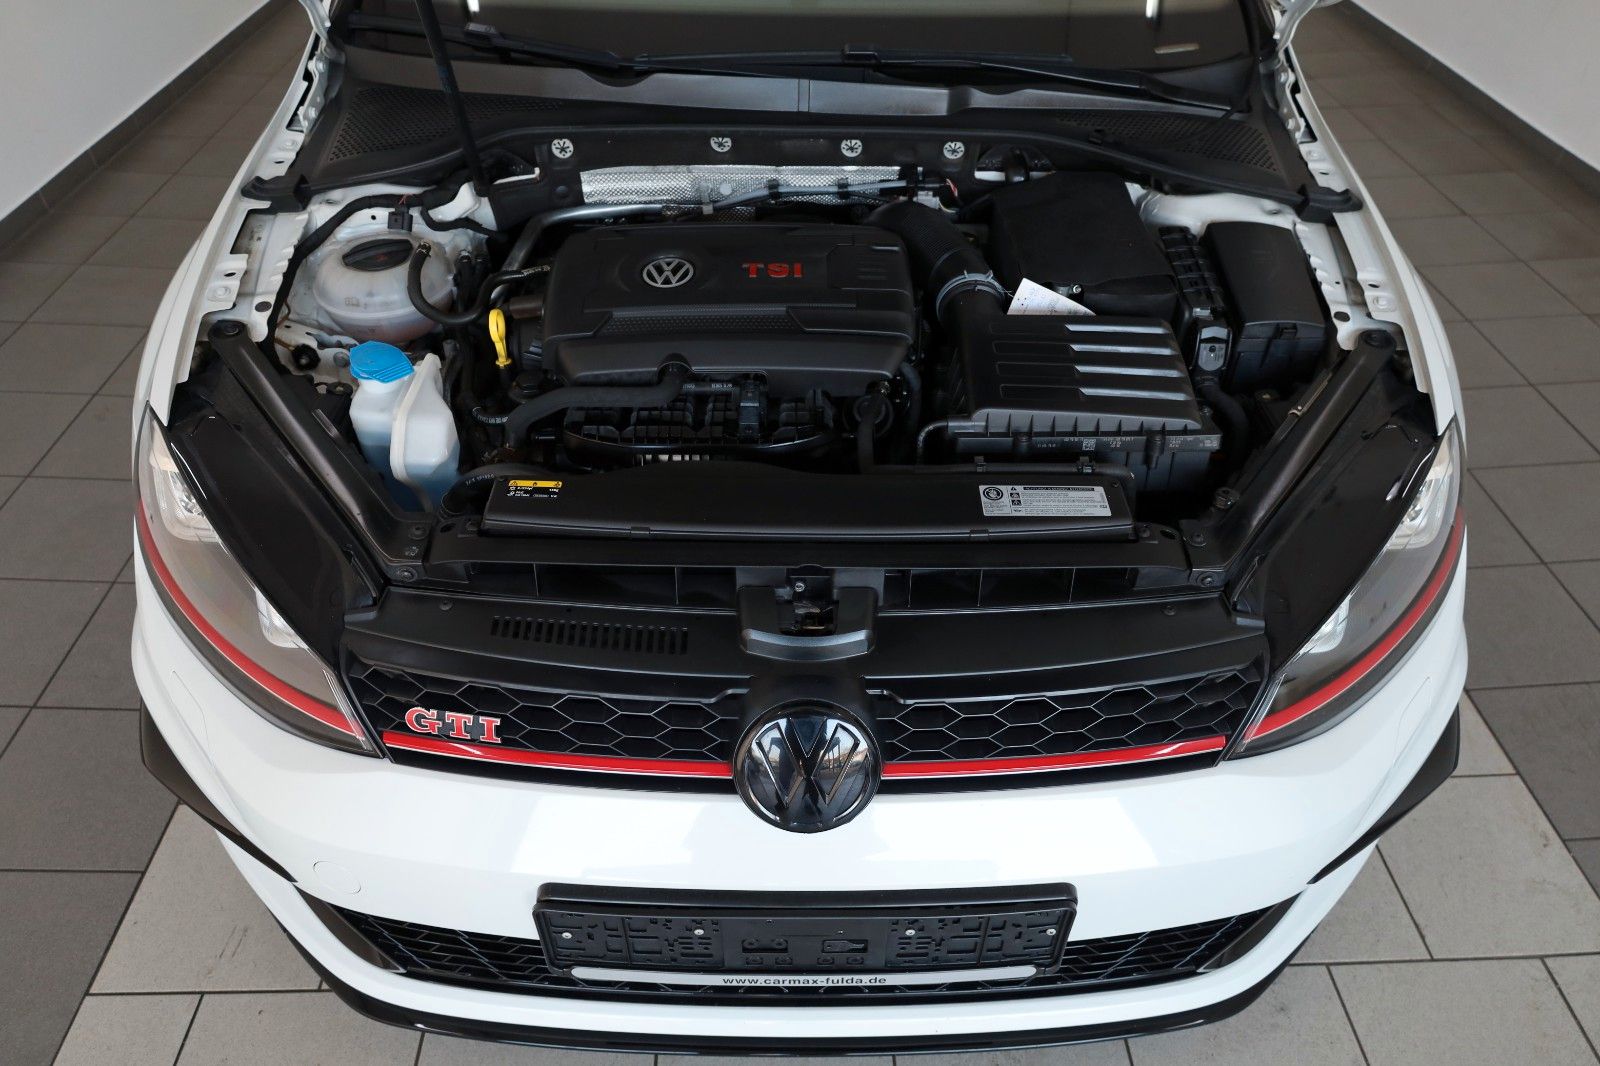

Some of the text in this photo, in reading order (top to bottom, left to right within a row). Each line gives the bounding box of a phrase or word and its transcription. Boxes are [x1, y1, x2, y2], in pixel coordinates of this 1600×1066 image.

[742, 262, 804, 278] TSI
[404, 706, 502, 744] GTI
[722, 976, 887, 985] www.carmax-fulda.de
